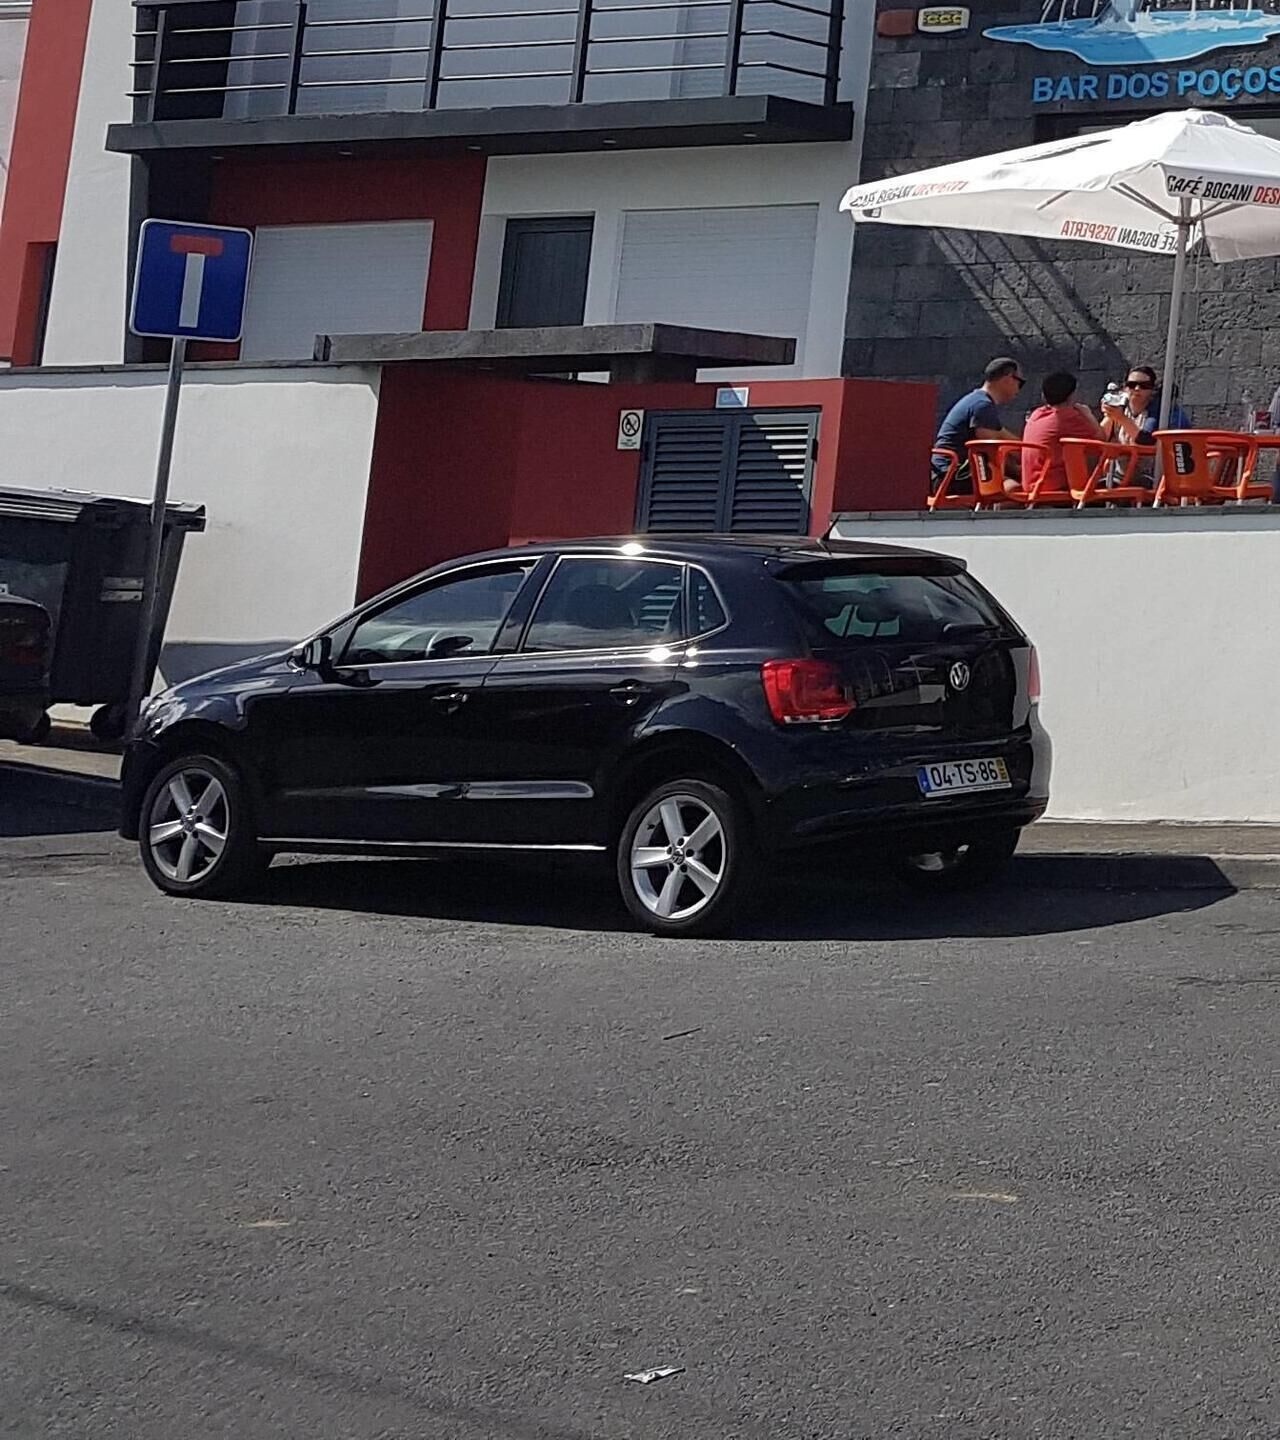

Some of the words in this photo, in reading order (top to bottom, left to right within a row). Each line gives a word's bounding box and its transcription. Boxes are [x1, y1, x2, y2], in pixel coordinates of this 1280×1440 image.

[1032, 73, 1099, 102] BAR
[1107, 71, 1169, 99] DOS
[1166, 174, 1203, 196] CAFÉ
[1202, 181, 1254, 202] BOGANI
